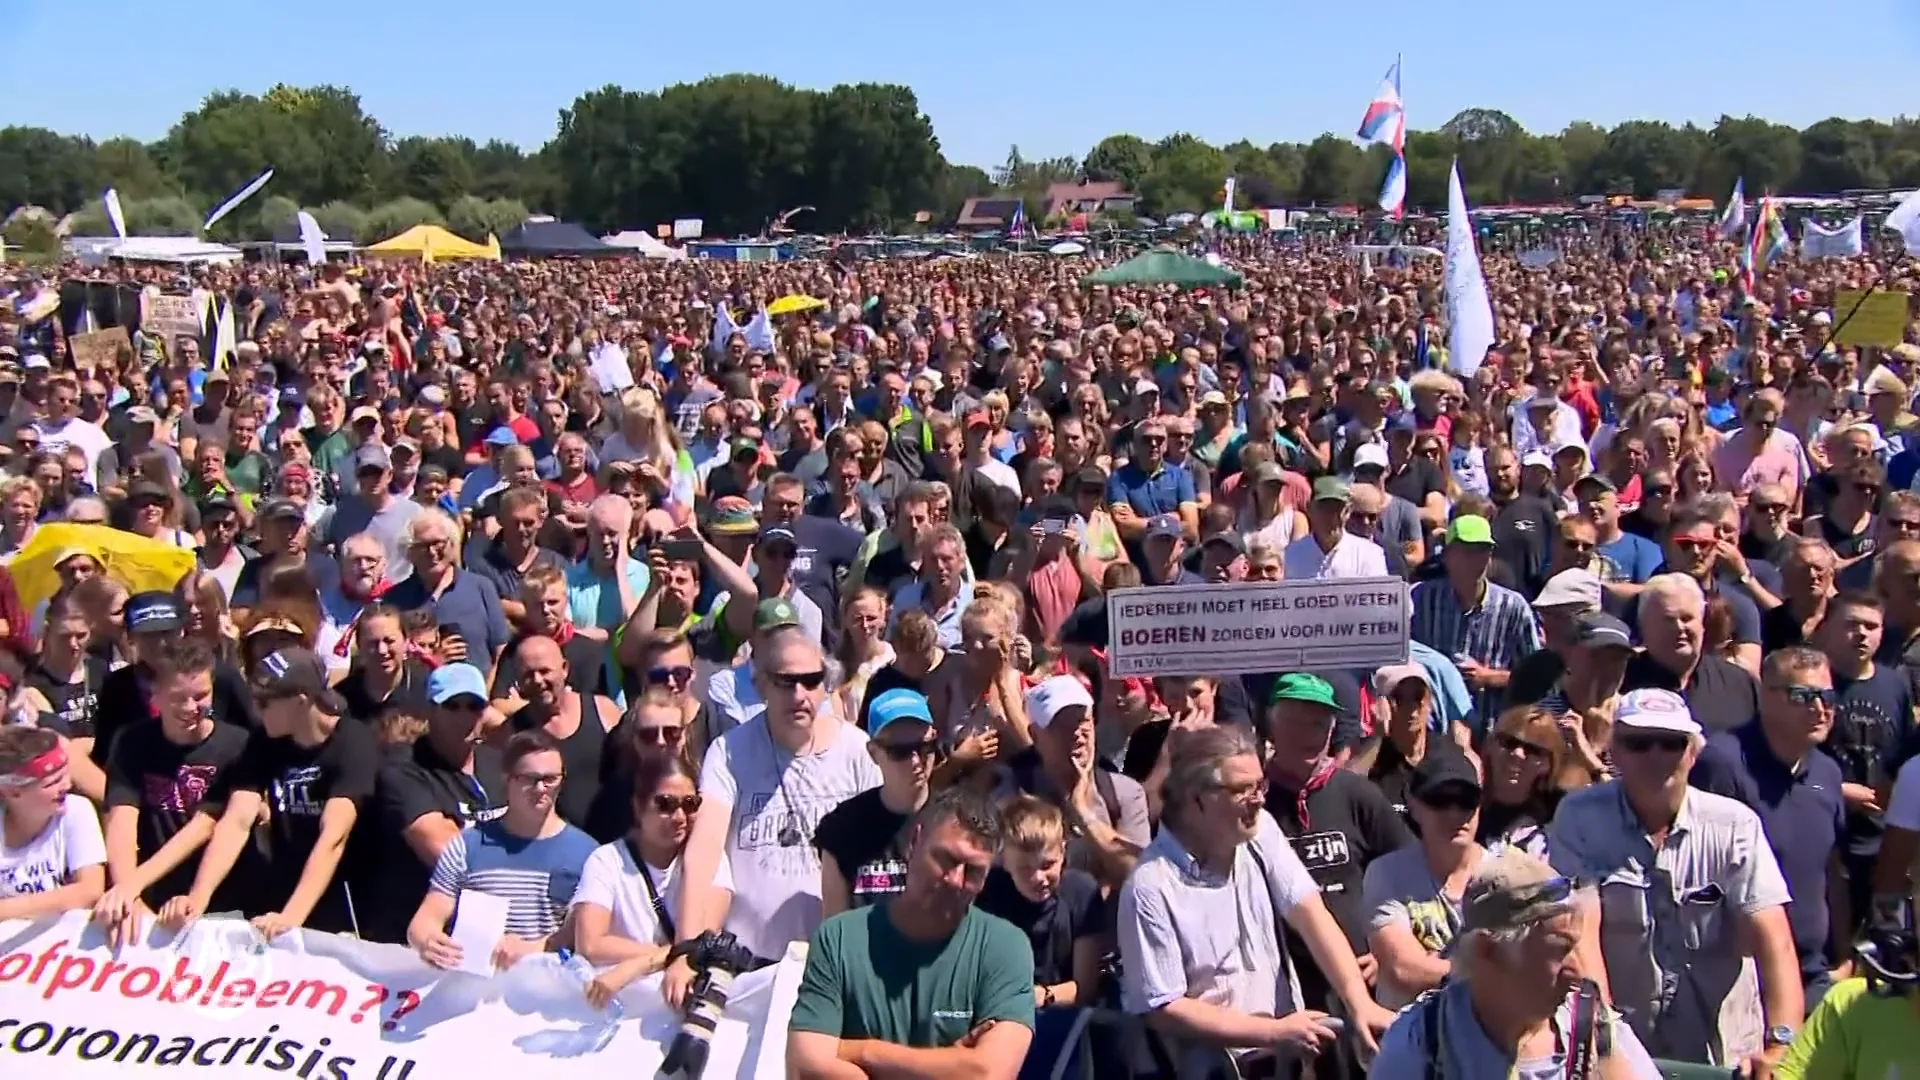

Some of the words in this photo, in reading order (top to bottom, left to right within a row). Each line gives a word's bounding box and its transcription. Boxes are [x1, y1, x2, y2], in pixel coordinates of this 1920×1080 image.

[1120, 601, 1198, 618] IEDEREEN
[1202, 598, 1246, 615] MOET
[1251, 597, 1290, 612] HEEL
[1294, 594, 1339, 610] GOED
[1344, 591, 1399, 607] WETEN
[1121, 626, 1206, 646] BOEREN
[1212, 627, 1275, 643] ZORGEN
[1280, 623, 1324, 639] VOOR
[1329, 622, 1354, 638] UW
[1359, 621, 1399, 637] ETEN
[1304, 837, 1346, 862] zijn
